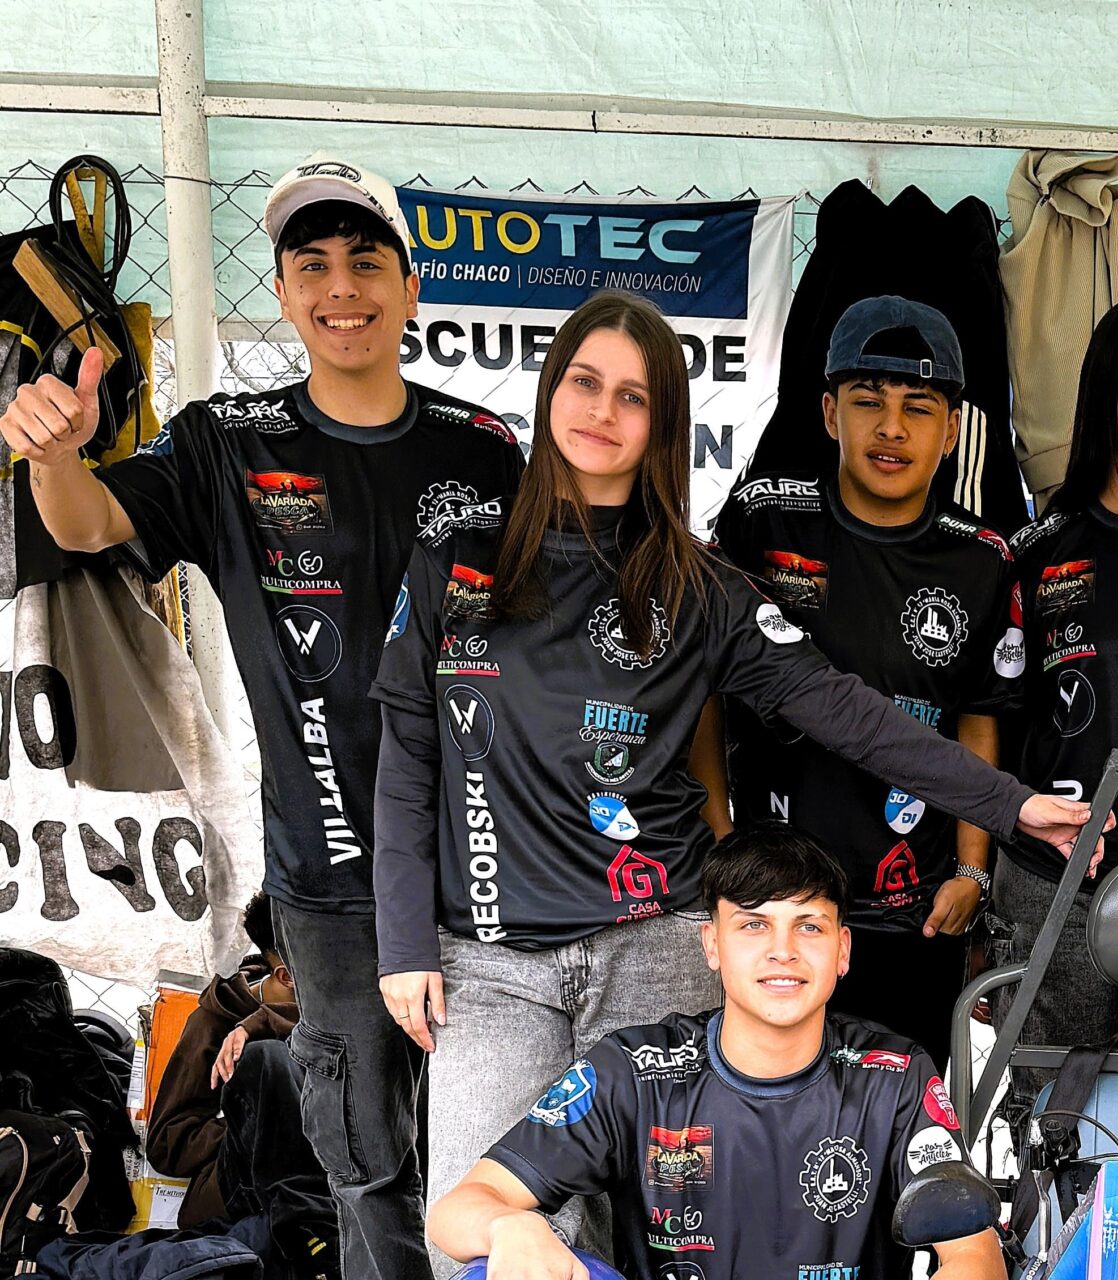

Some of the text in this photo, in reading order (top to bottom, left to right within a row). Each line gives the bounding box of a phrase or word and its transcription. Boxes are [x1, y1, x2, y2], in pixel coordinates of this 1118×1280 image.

[404, 204, 705, 264] UTOTEC
[452, 264, 510, 283] CHACO
[528, 266, 586, 287] DISEÑO
[591, 271, 601, 288] E
[604, 271, 701, 293] INNOVACIÓN
[940, 516, 977, 534] PUMA
[583, 704, 650, 735] FUERTE
[579, 723, 647, 746] Esperanza
[300, 696, 363, 867] VILLALBA
[628, 901, 661, 915] CASA
